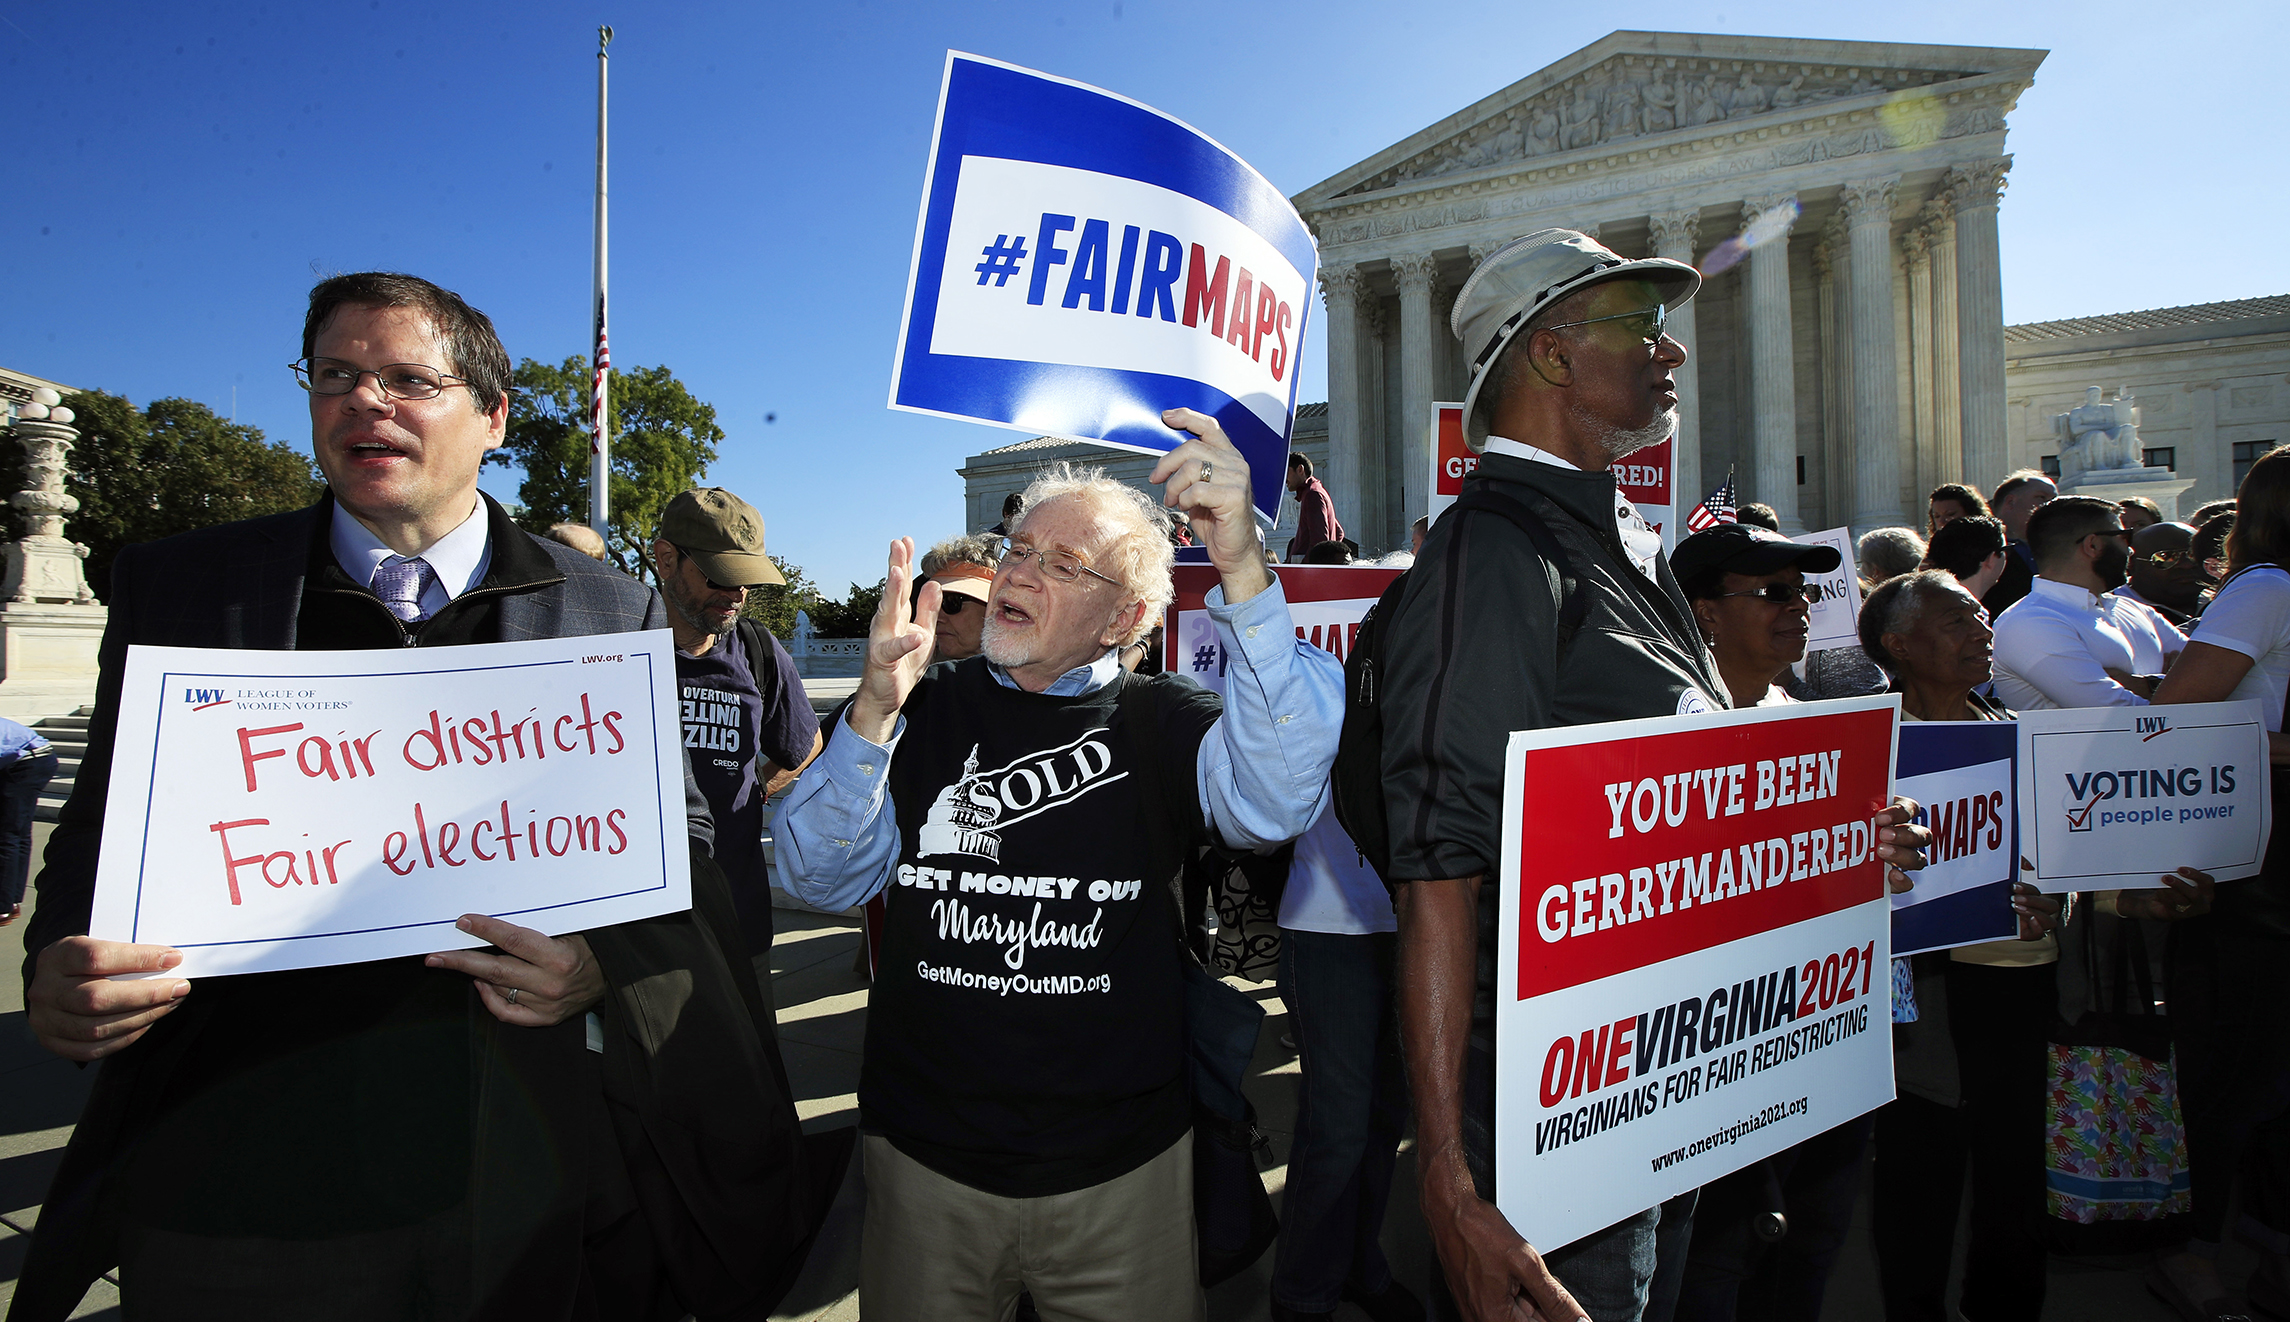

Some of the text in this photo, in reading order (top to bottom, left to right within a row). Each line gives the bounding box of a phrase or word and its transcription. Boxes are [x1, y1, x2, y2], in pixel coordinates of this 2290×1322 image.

[974, 212, 1292, 382] #FAIRMAPS
[581, 653, 624, 664] LWV.org
[184, 688, 225, 703] LWV
[236, 702, 292, 711] WOMEN
[237, 690, 316, 699] LEAGUE OF
[683, 686, 741, 706] OVERTURN
[678, 700, 741, 728] UNITE
[2135, 716, 2167, 734] LWV
[237, 692, 626, 793] Fair districts
[684, 724, 740, 753] CITIZ
[712, 758, 739, 768] CREDO
[970, 740, 1112, 822] SOLD
[1604, 749, 1842, 840] YOU'VE BEEN
[2065, 764, 2236, 801] VOTING IS
[2100, 803, 2235, 828] people power
[209, 800, 629, 906] Fair elections
[897, 863, 1142, 902] GET MONEY OUT
[1536, 816, 1877, 944] GERRYMANDERED!
[930, 898, 1104, 970] Maryland
[917, 961, 1111, 996] GetMoneyOutMD.org
[1538, 940, 1875, 1109] ONEVIRGINIA2021
[1535, 1004, 1868, 1157] VIRGINIANS FOR FAIR REDISTRICTING
[1651, 1096, 1809, 1173] www.onevirginia2021.org
